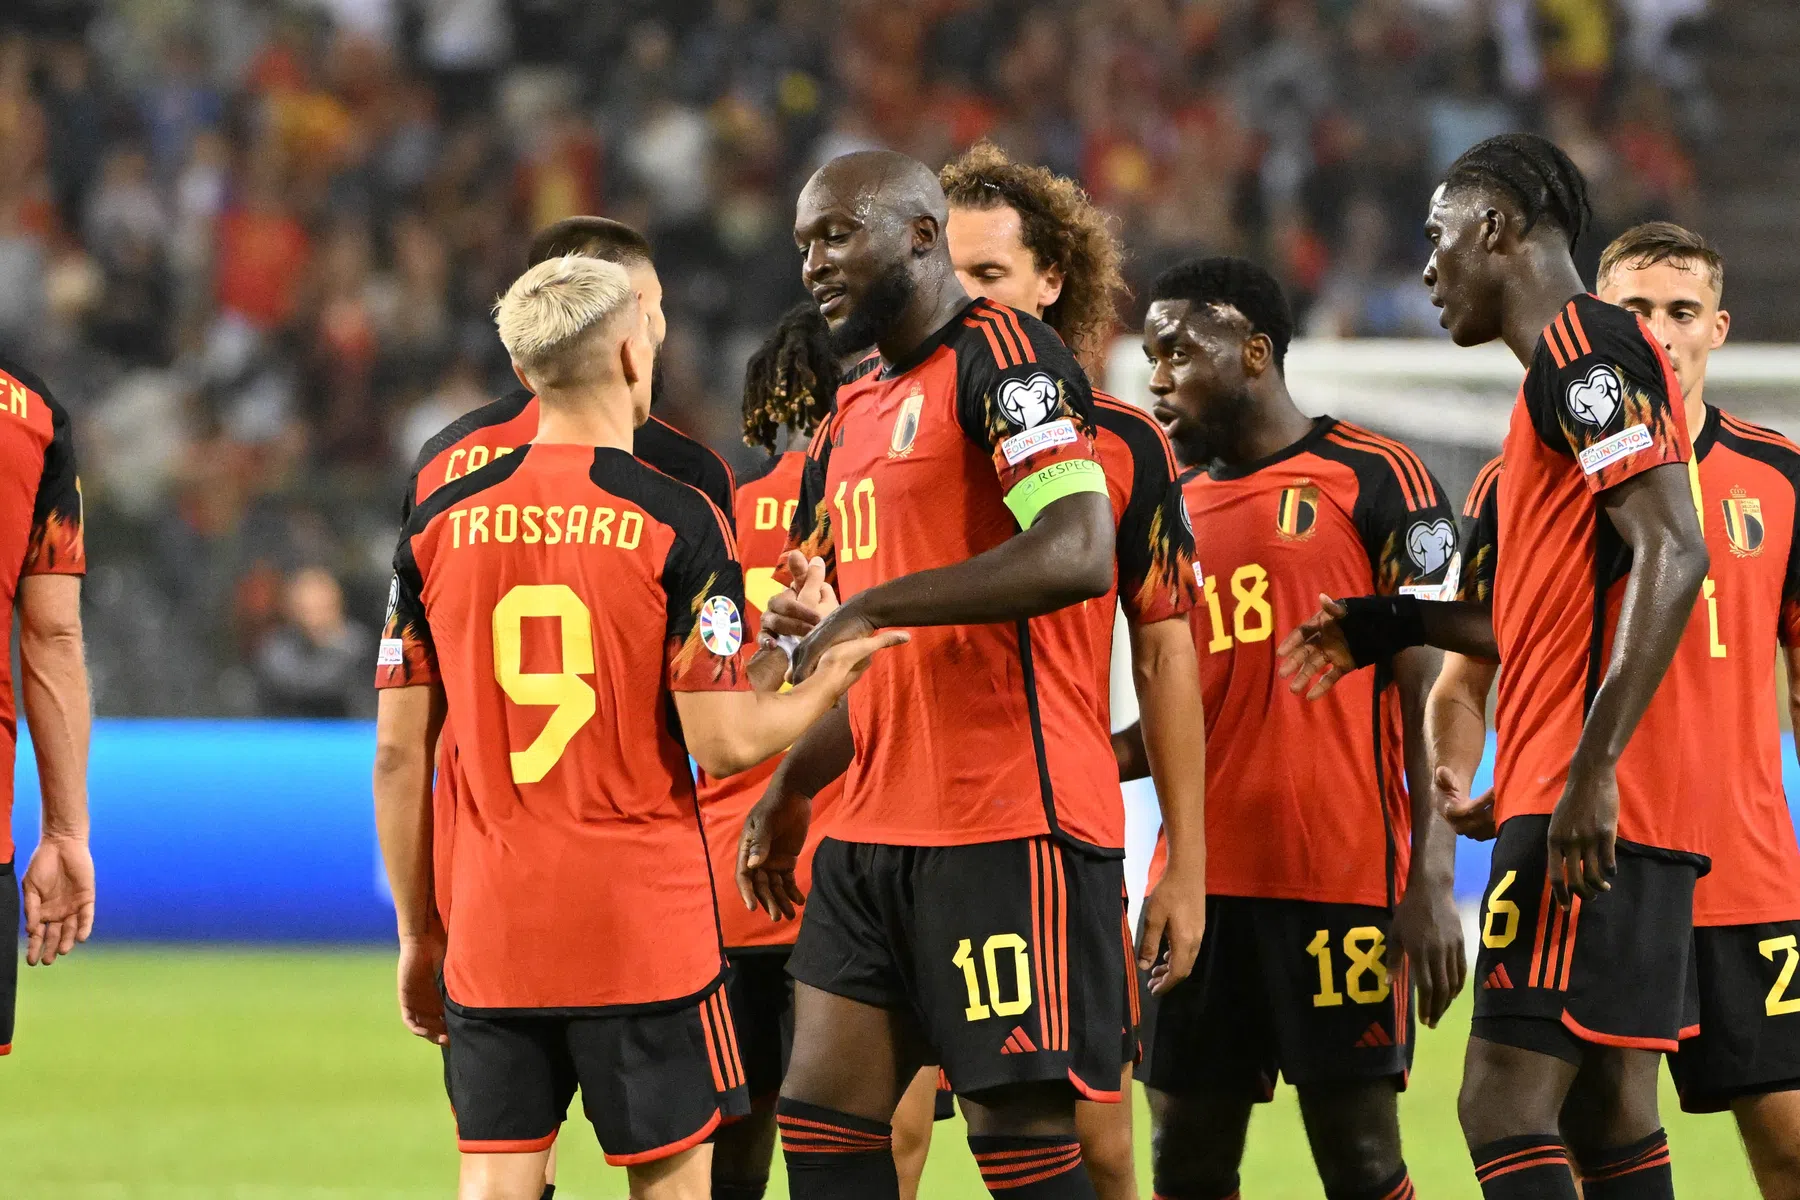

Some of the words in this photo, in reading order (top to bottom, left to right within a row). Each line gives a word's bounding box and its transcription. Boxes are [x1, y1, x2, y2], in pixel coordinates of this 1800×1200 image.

[1006, 426, 1073, 457] FOUNDATION
[1583, 431, 1648, 466] FOUNDATION
[449, 504, 644, 550] TROSSARD
[834, 478, 877, 563] 10
[1203, 563, 1272, 654] 18
[492, 584, 596, 784] 9
[1482, 870, 1520, 949] 6
[952, 933, 1032, 1021] 10
[1306, 926, 1390, 1007] 18
[1758, 934, 1800, 1016] 2
